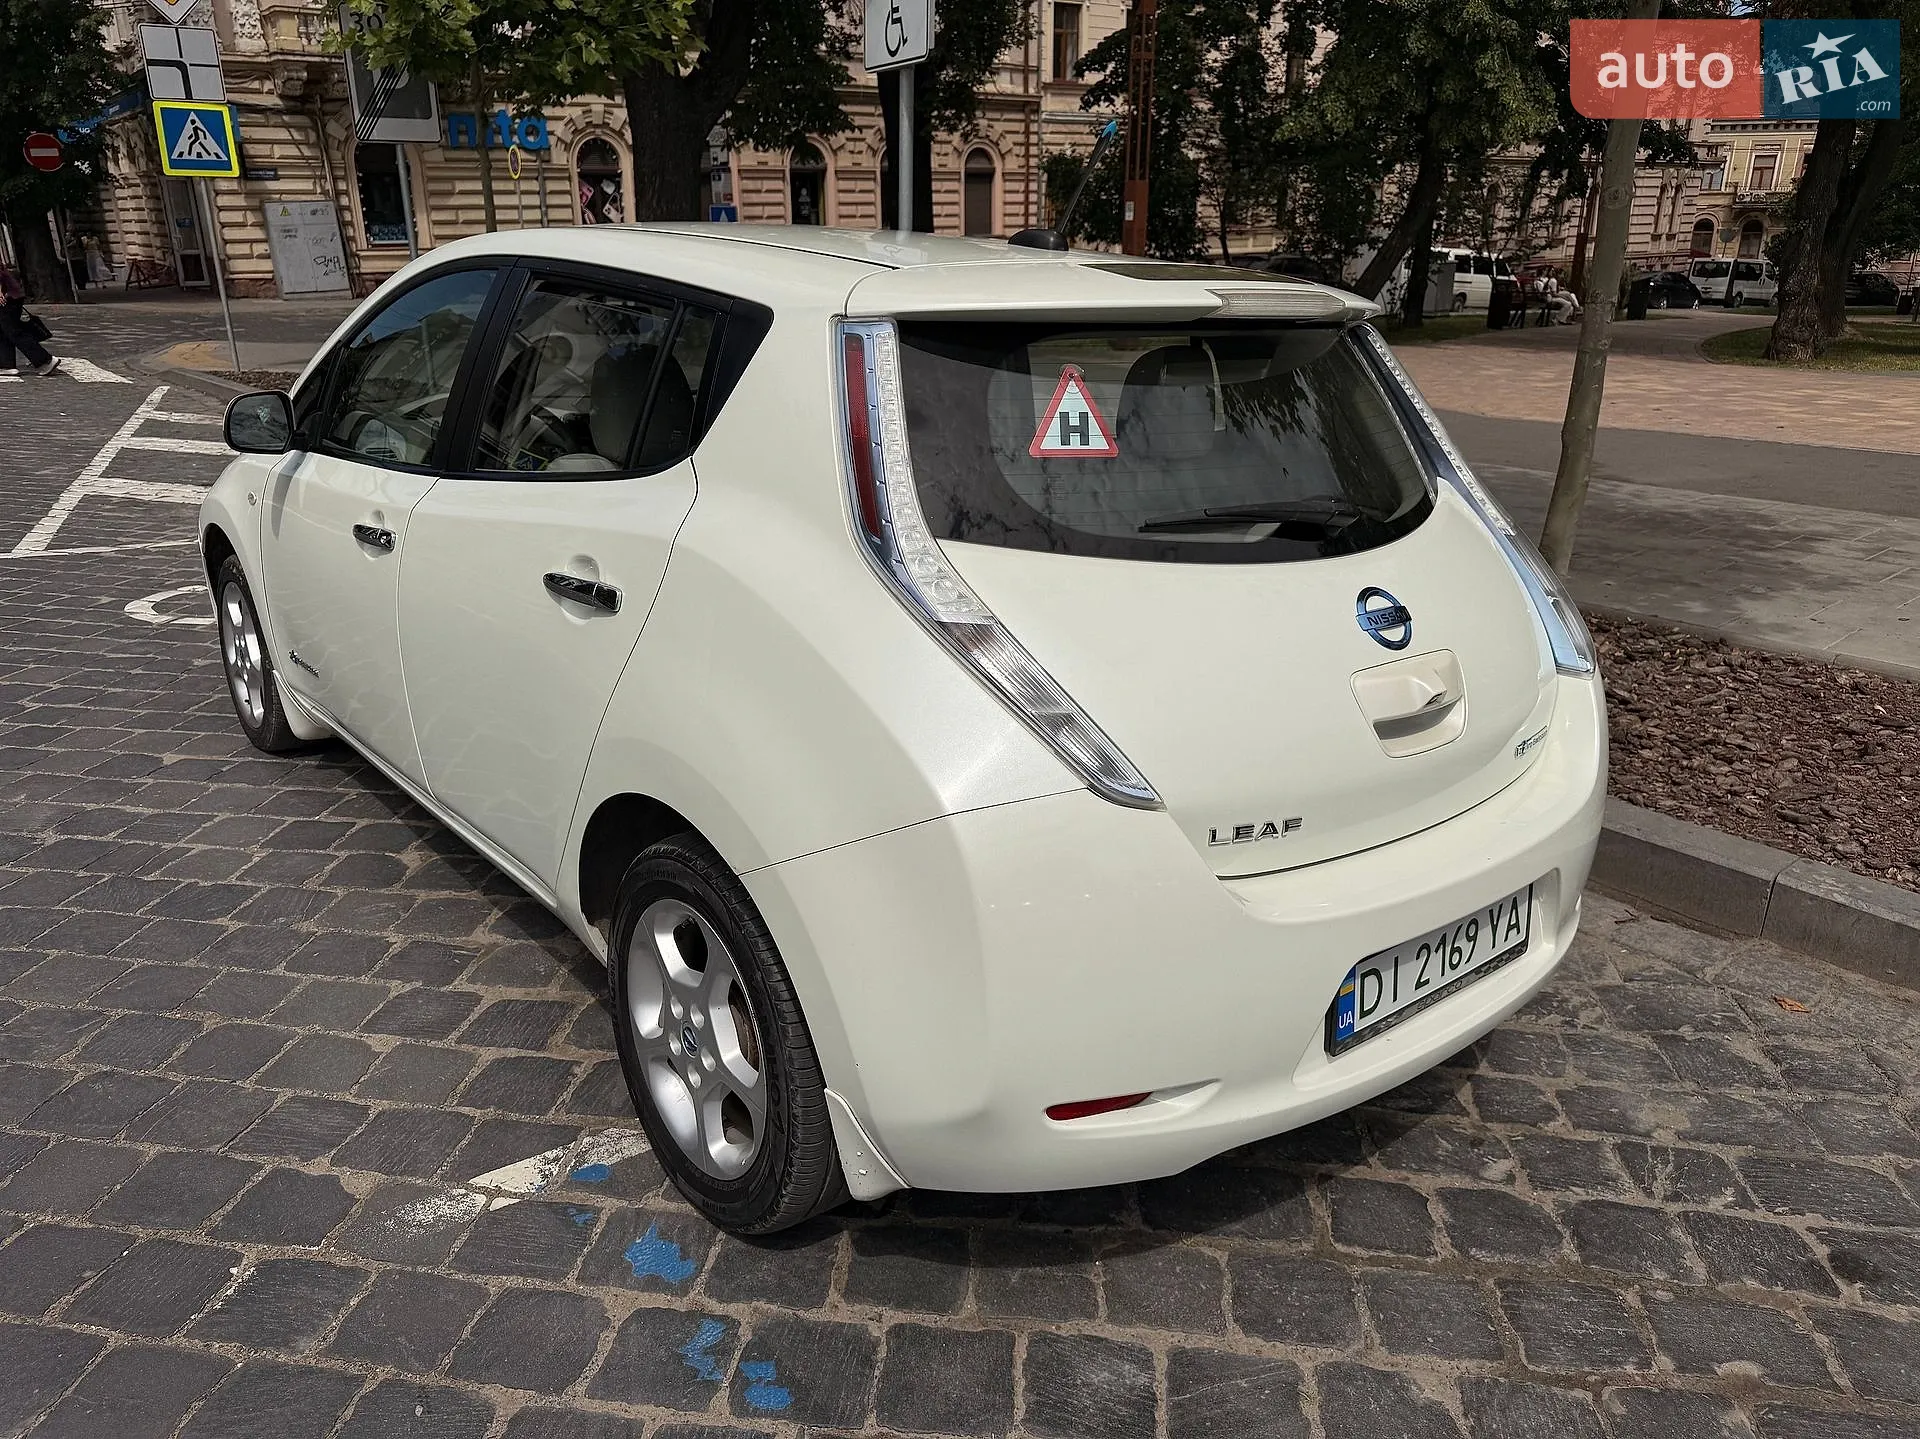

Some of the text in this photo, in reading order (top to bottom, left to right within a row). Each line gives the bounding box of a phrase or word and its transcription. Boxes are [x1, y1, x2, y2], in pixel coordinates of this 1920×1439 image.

[1366, 607, 1409, 627] NISSA
[1207, 817, 1303, 847] LEAF
[1358, 896, 1521, 1021] DI 2169 YA
[1338, 1010, 1354, 1029] UA
